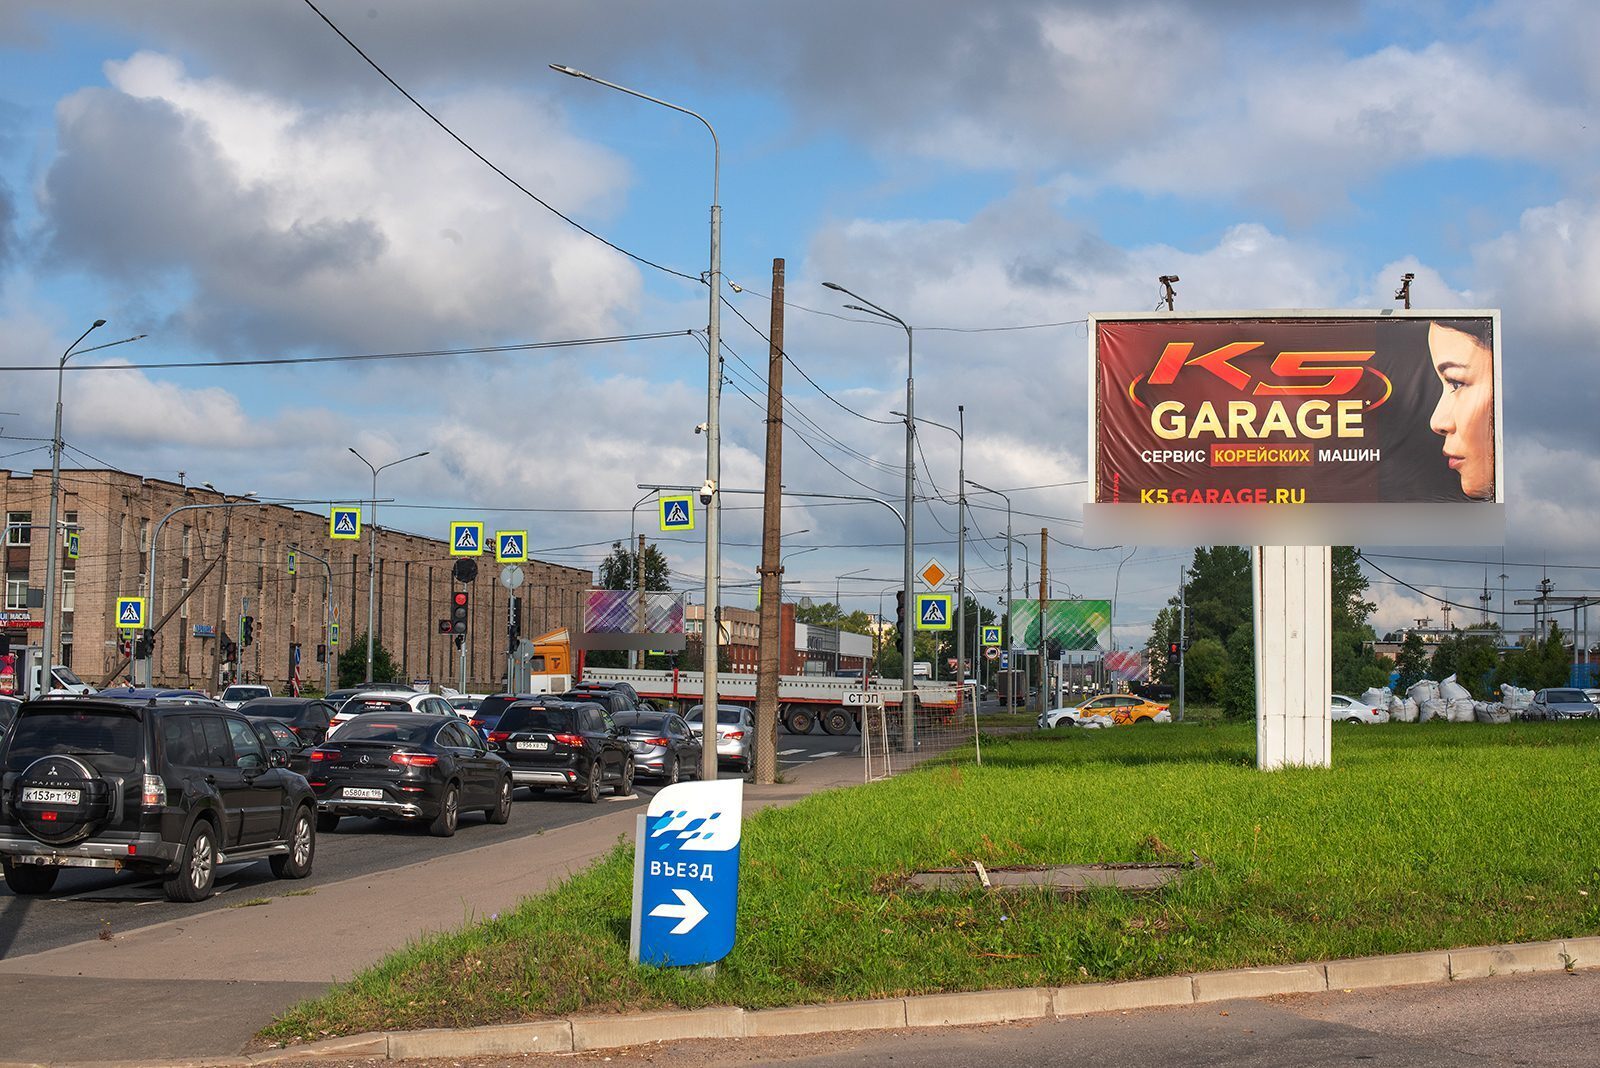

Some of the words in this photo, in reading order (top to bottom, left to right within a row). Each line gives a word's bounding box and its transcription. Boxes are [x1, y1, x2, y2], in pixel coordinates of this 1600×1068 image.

[1147, 341, 1376, 396] K5
[1150, 400, 1365, 440] GARAGE
[1141, 449, 1206, 464] СЕРВИС
[1214, 446, 1311, 463] КОРЕЙСКИХ
[1318, 448, 1381, 463] МАШИН
[848, 693, 879, 704] СТОП
[650, 861, 714, 881] ВЪЕЗД
